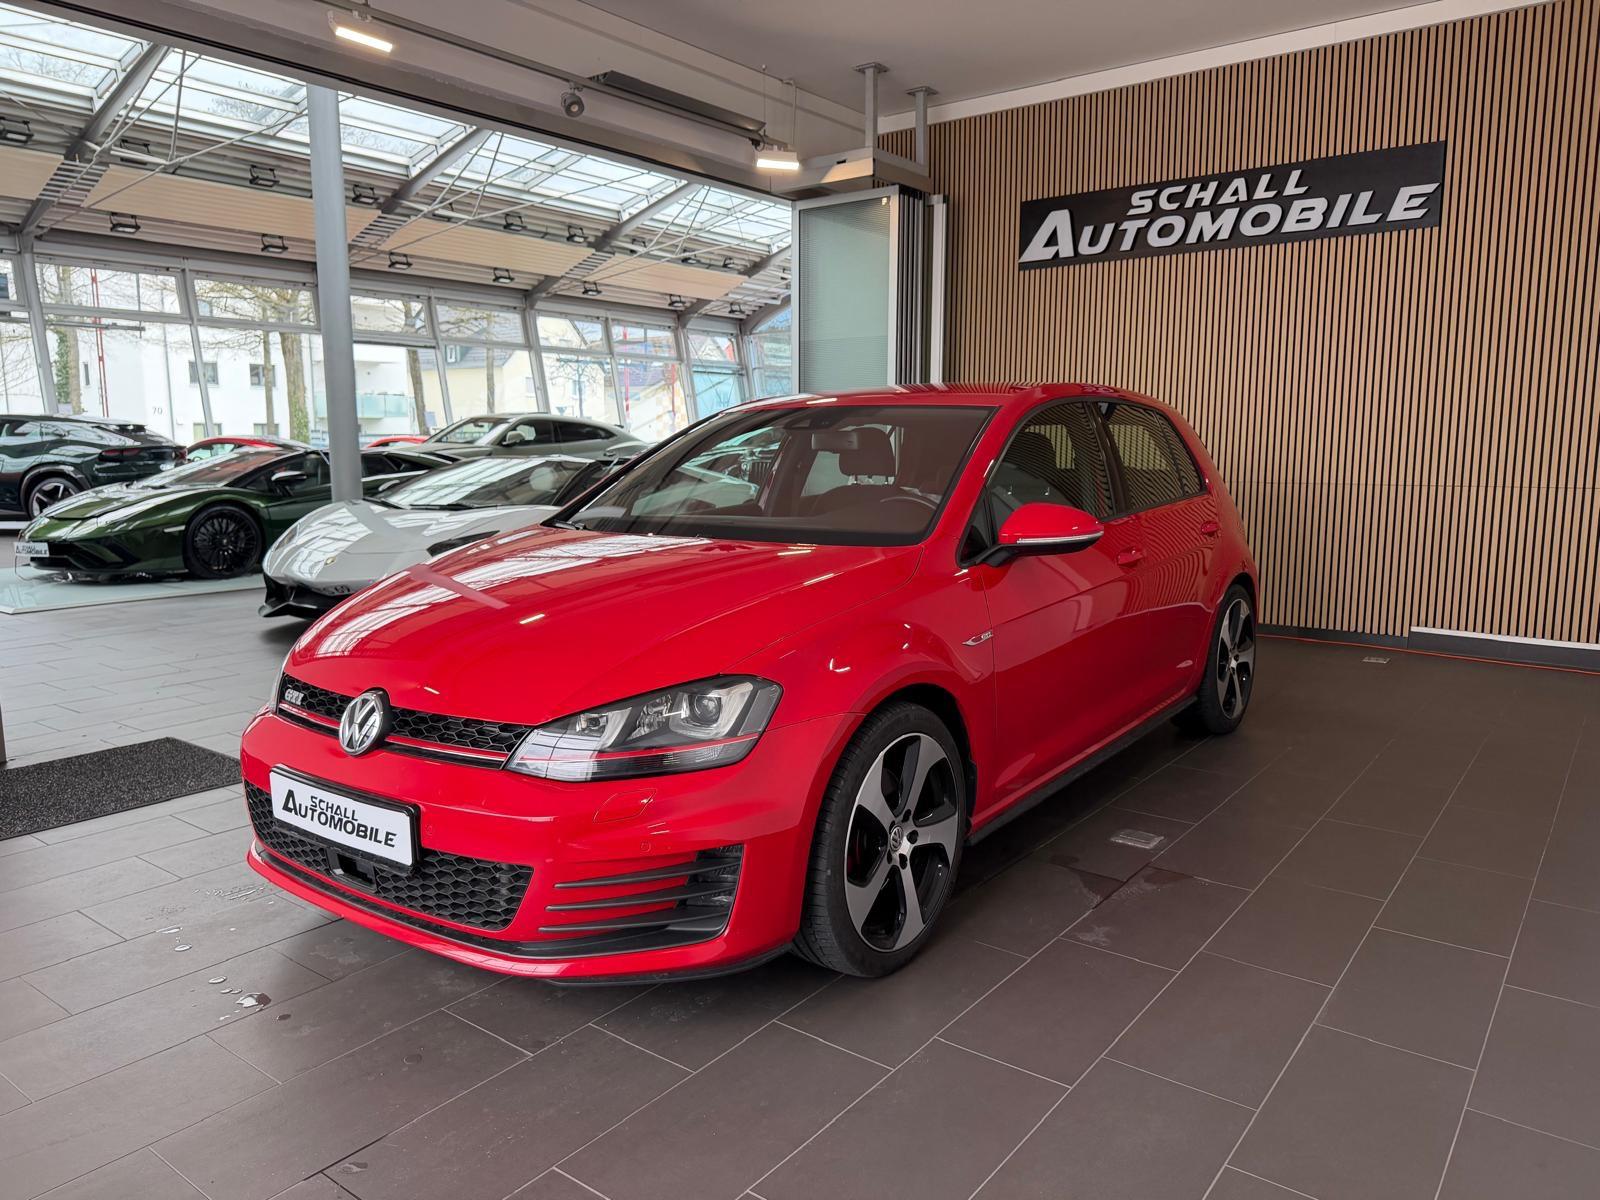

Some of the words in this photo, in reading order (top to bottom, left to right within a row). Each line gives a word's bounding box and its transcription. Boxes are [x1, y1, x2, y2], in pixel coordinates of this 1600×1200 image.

[1127, 169, 1310, 216] SCHALL
[1018, 182, 1441, 263] AUTOMOBILE
[152, 406, 163, 415] 70
[284, 688, 304, 705] GTI
[282, 789, 398, 848] AUTOMOBILE
[310, 795, 359, 822] SCHALL
